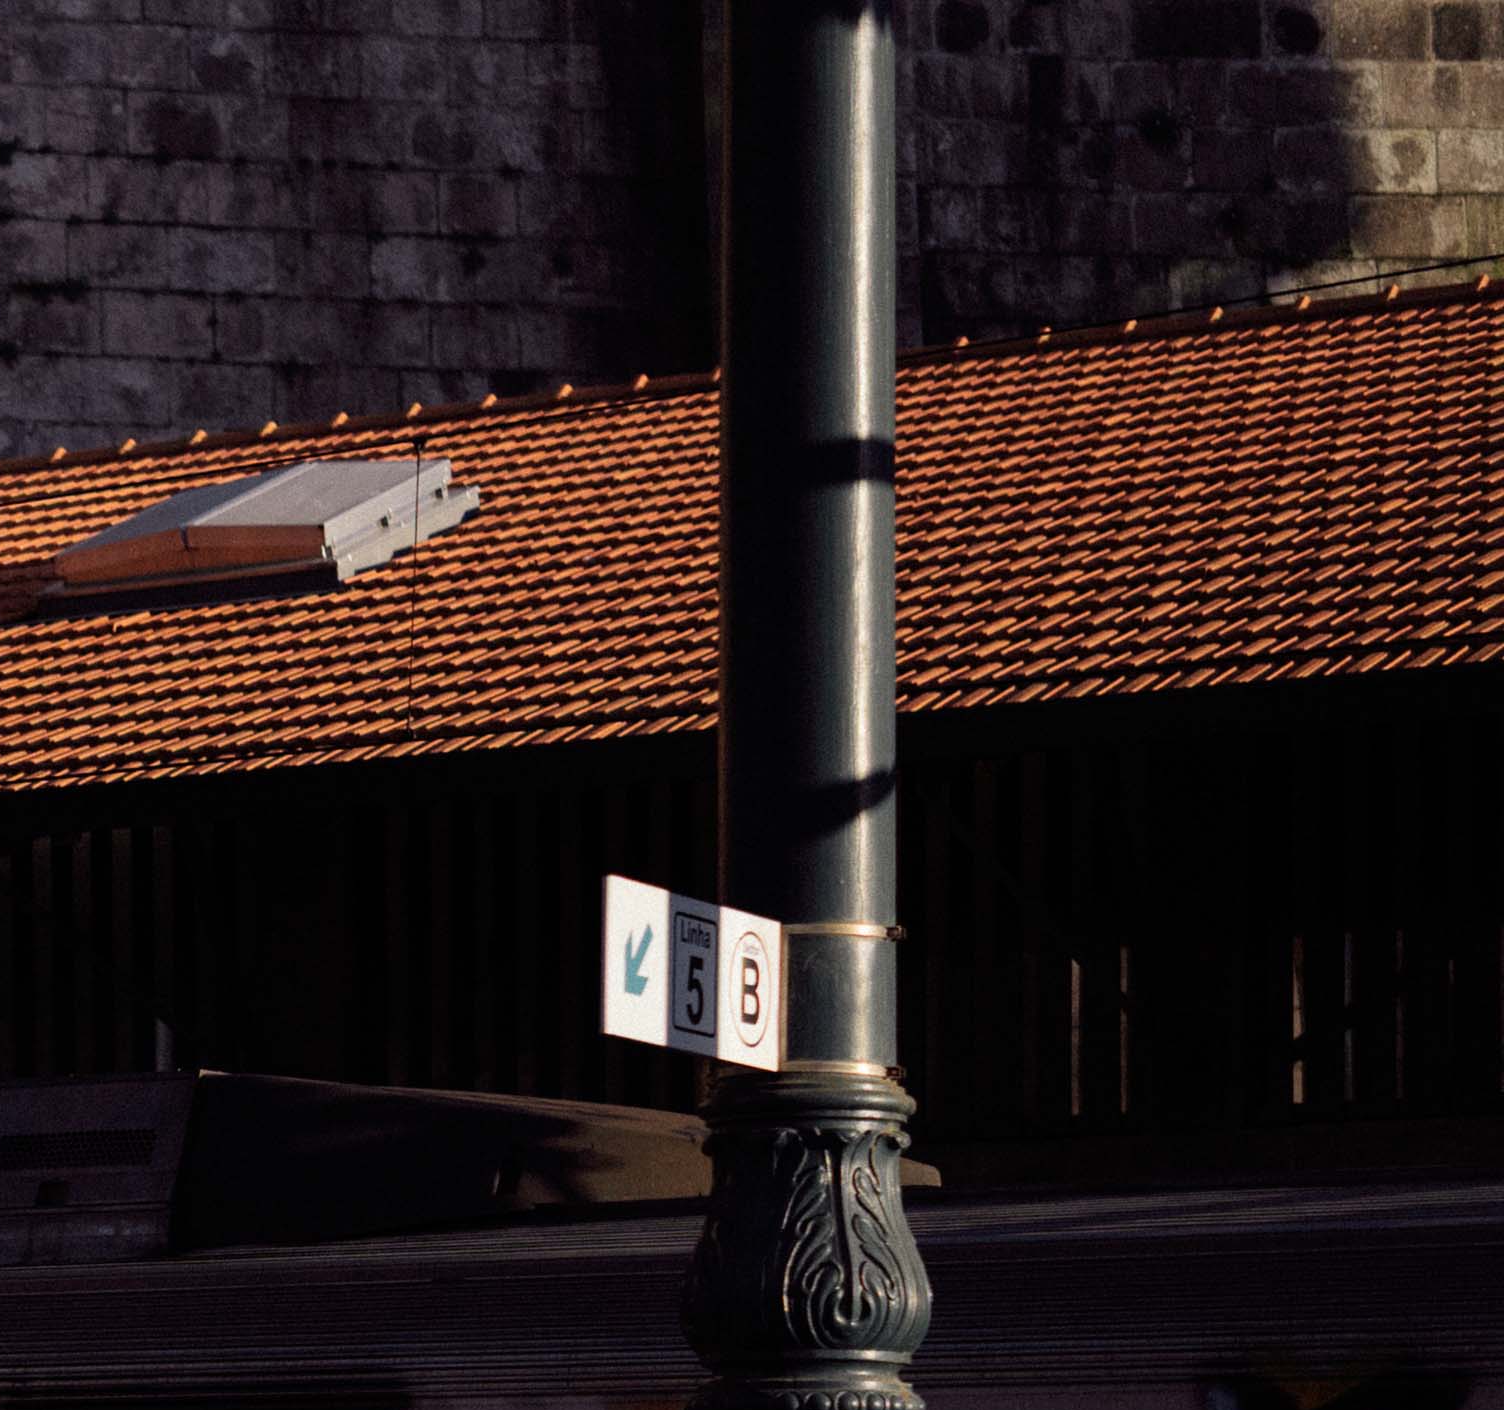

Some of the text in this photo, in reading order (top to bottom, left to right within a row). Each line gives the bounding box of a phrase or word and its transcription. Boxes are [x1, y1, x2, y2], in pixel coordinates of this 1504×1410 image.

[680, 919, 710, 949] Linha
[687, 956, 703, 1025] 5
[741, 957, 760, 1025] B
